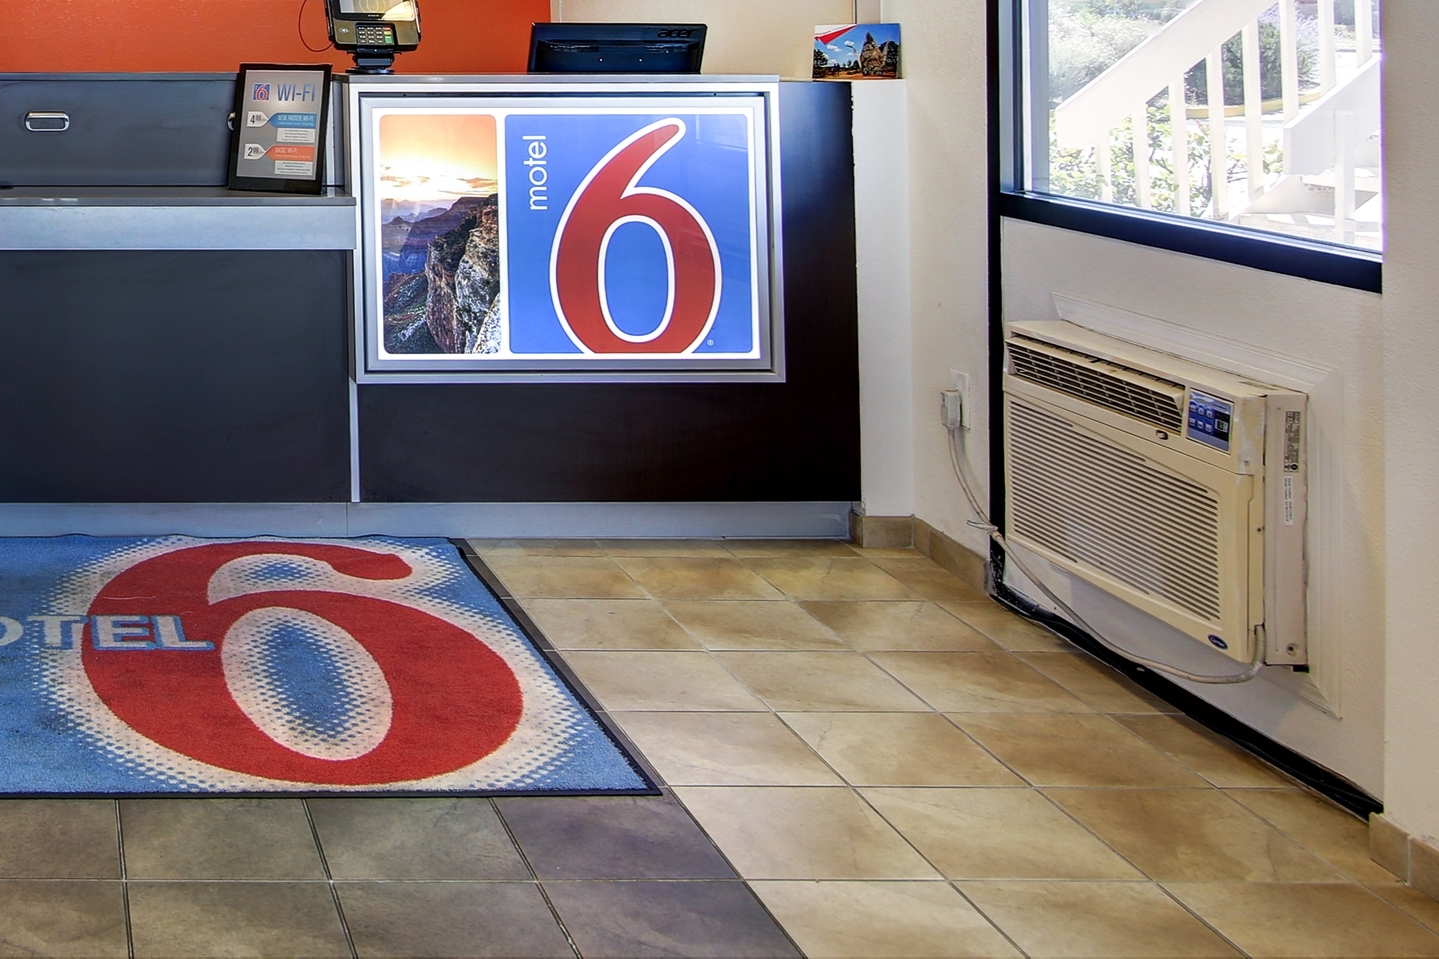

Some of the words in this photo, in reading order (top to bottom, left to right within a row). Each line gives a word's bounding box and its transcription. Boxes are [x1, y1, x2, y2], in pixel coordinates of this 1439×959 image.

[255, 83, 268, 101] 6
[277, 83, 315, 101] WI-FI
[657, 28, 698, 38] acer
[522, 135, 548, 211] motel
[549, 117, 722, 354] 6
[81, 540, 524, 786] 6
